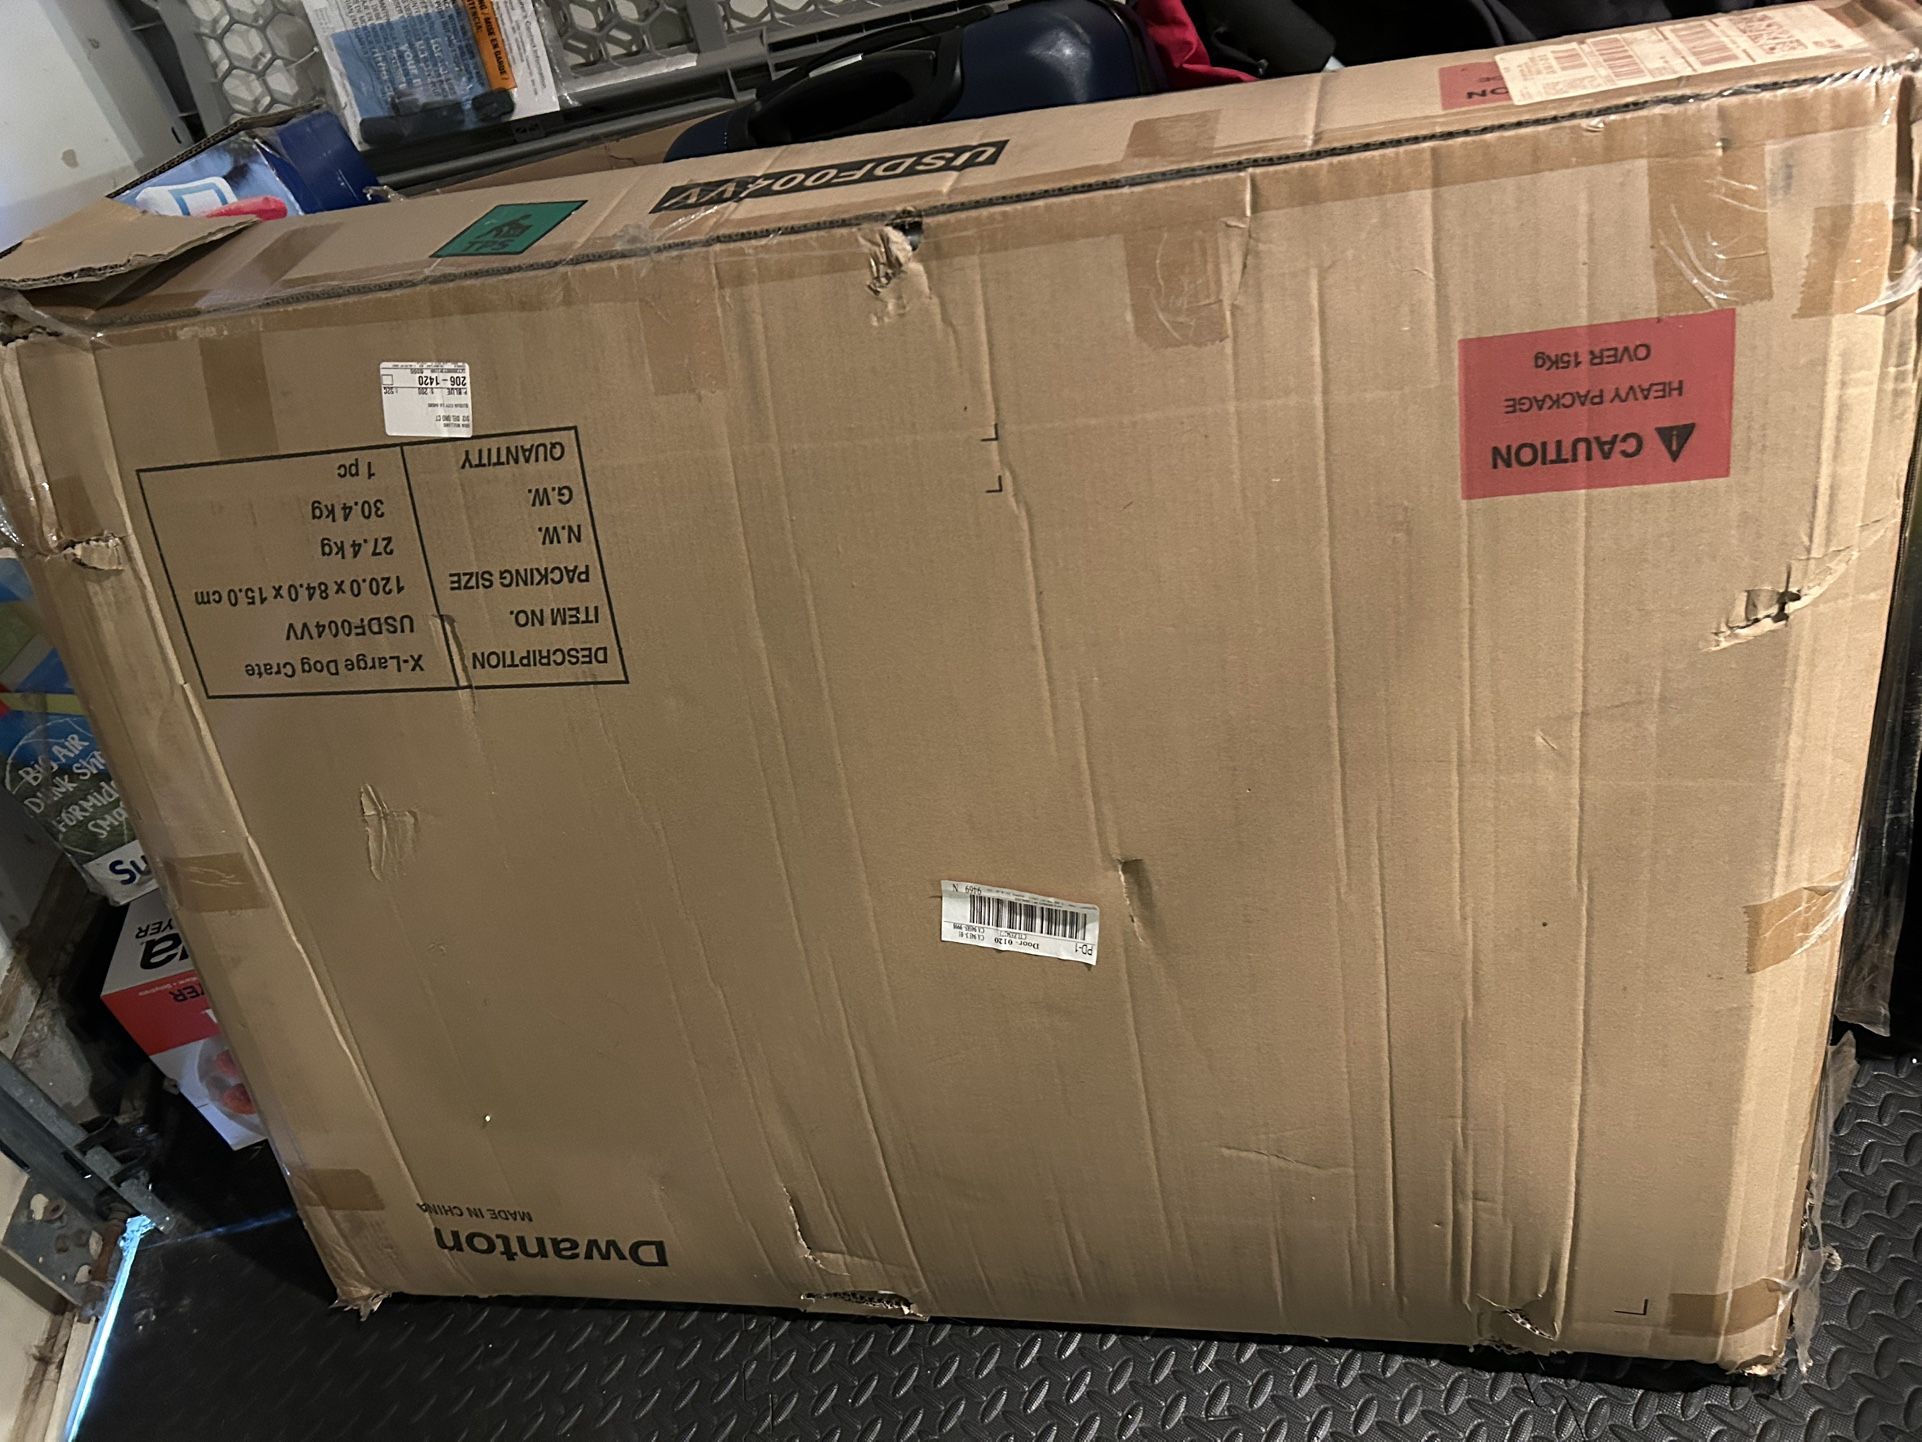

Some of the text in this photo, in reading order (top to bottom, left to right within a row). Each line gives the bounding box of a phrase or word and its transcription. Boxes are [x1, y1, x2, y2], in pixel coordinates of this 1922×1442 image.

[461, 239, 515, 252] TPS
[1534, 343, 1651, 371] OVER 15Kg
[1504, 380, 1684, 414] HEAVY PACKAGE
[461, 441, 566, 469] QUANTITY
[1491, 431, 1644, 470] CAUTION
[337, 458, 376, 480] 1 pc
[528, 485, 573, 507] G.W.
[311, 499, 385, 523] 30.4 kg
[538, 524, 582, 545] N.W.
[320, 536, 394, 559] 27.4 kg
[449, 565, 590, 591] PACKING SIZE
[194, 575, 405, 607] 120.0 x 84.0 x 15.0 cm
[510, 606, 599, 627] ITEM NO.
[245, 653, 425, 678] X-Large Dog Crate
[472, 646, 608, 669] DESCRIPTION
[994, 937, 1013, 946] 0120
[1074, 942, 1093, 956] PD-1
[416, 1202, 533, 1223] MADE IN CHINA
[434, 1226, 669, 1268] Dwanton
